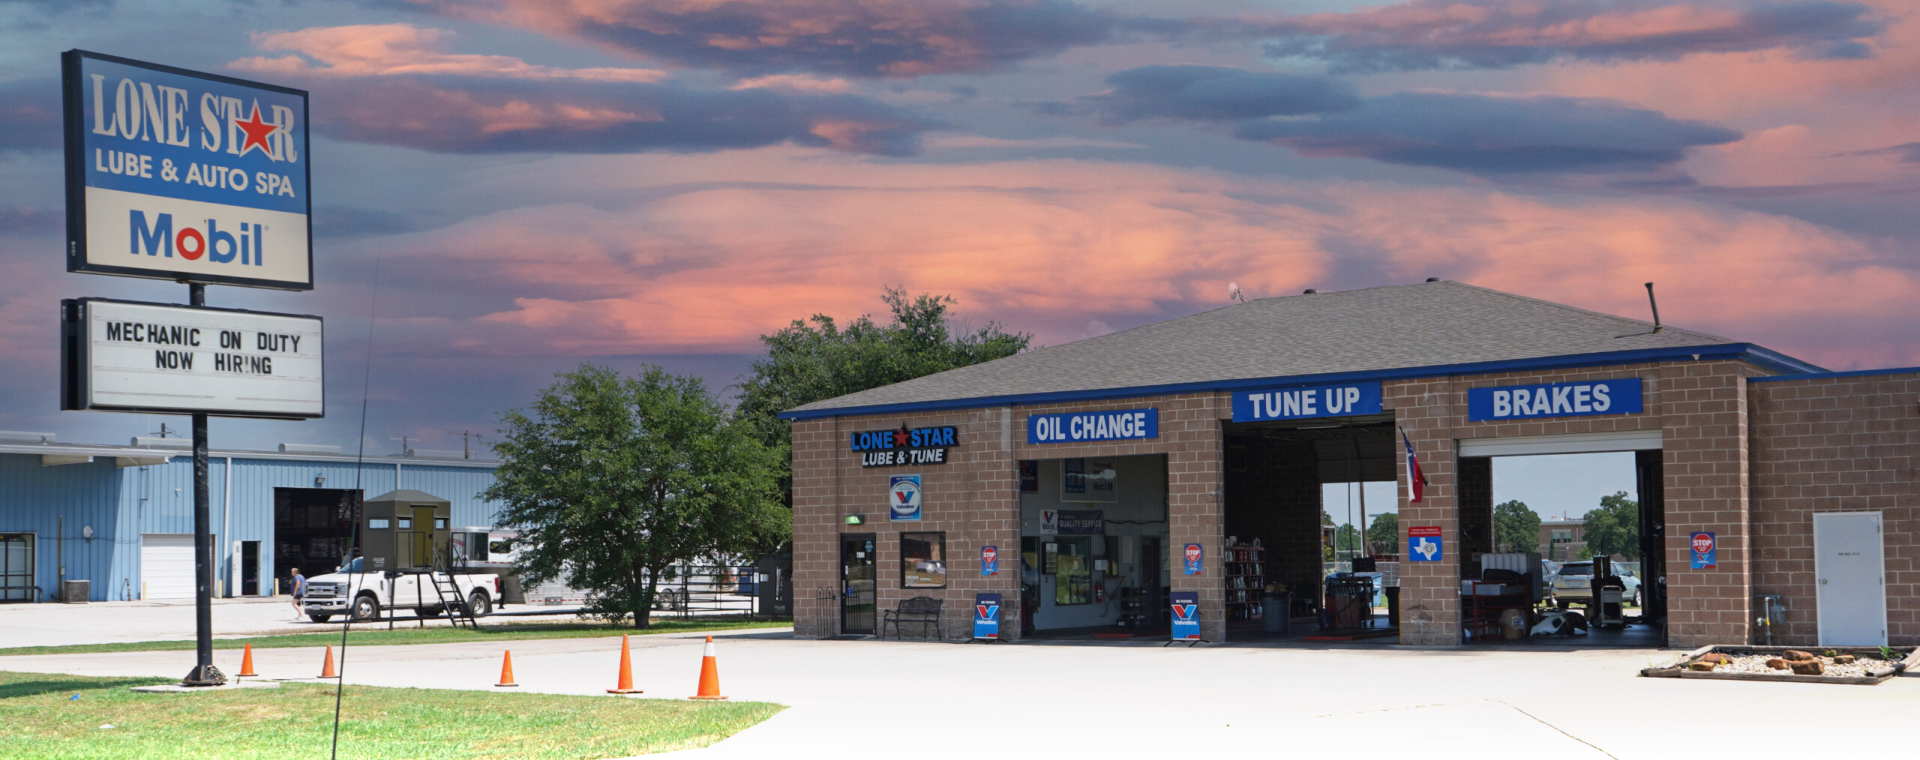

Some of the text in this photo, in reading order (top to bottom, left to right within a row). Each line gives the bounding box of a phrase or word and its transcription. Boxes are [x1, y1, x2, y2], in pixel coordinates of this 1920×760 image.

[91, 74, 190, 147] LONE
[96, 148, 296, 198] LUBE & AUTO SPA
[129, 209, 263, 267] Mobil
[106, 322, 301, 352] MECHANIC ON DUTY
[156, 350, 194, 370] NOW
[1248, 387, 1360, 419] TUNE UP
[1493, 384, 1611, 417] BRAKES
[851, 427, 955, 450] LONE STAR
[1036, 412, 1146, 442] OIL CHANGE
[862, 448, 944, 467] LUBE & TUNE
[1082, 520, 1102, 528] SERVICE
